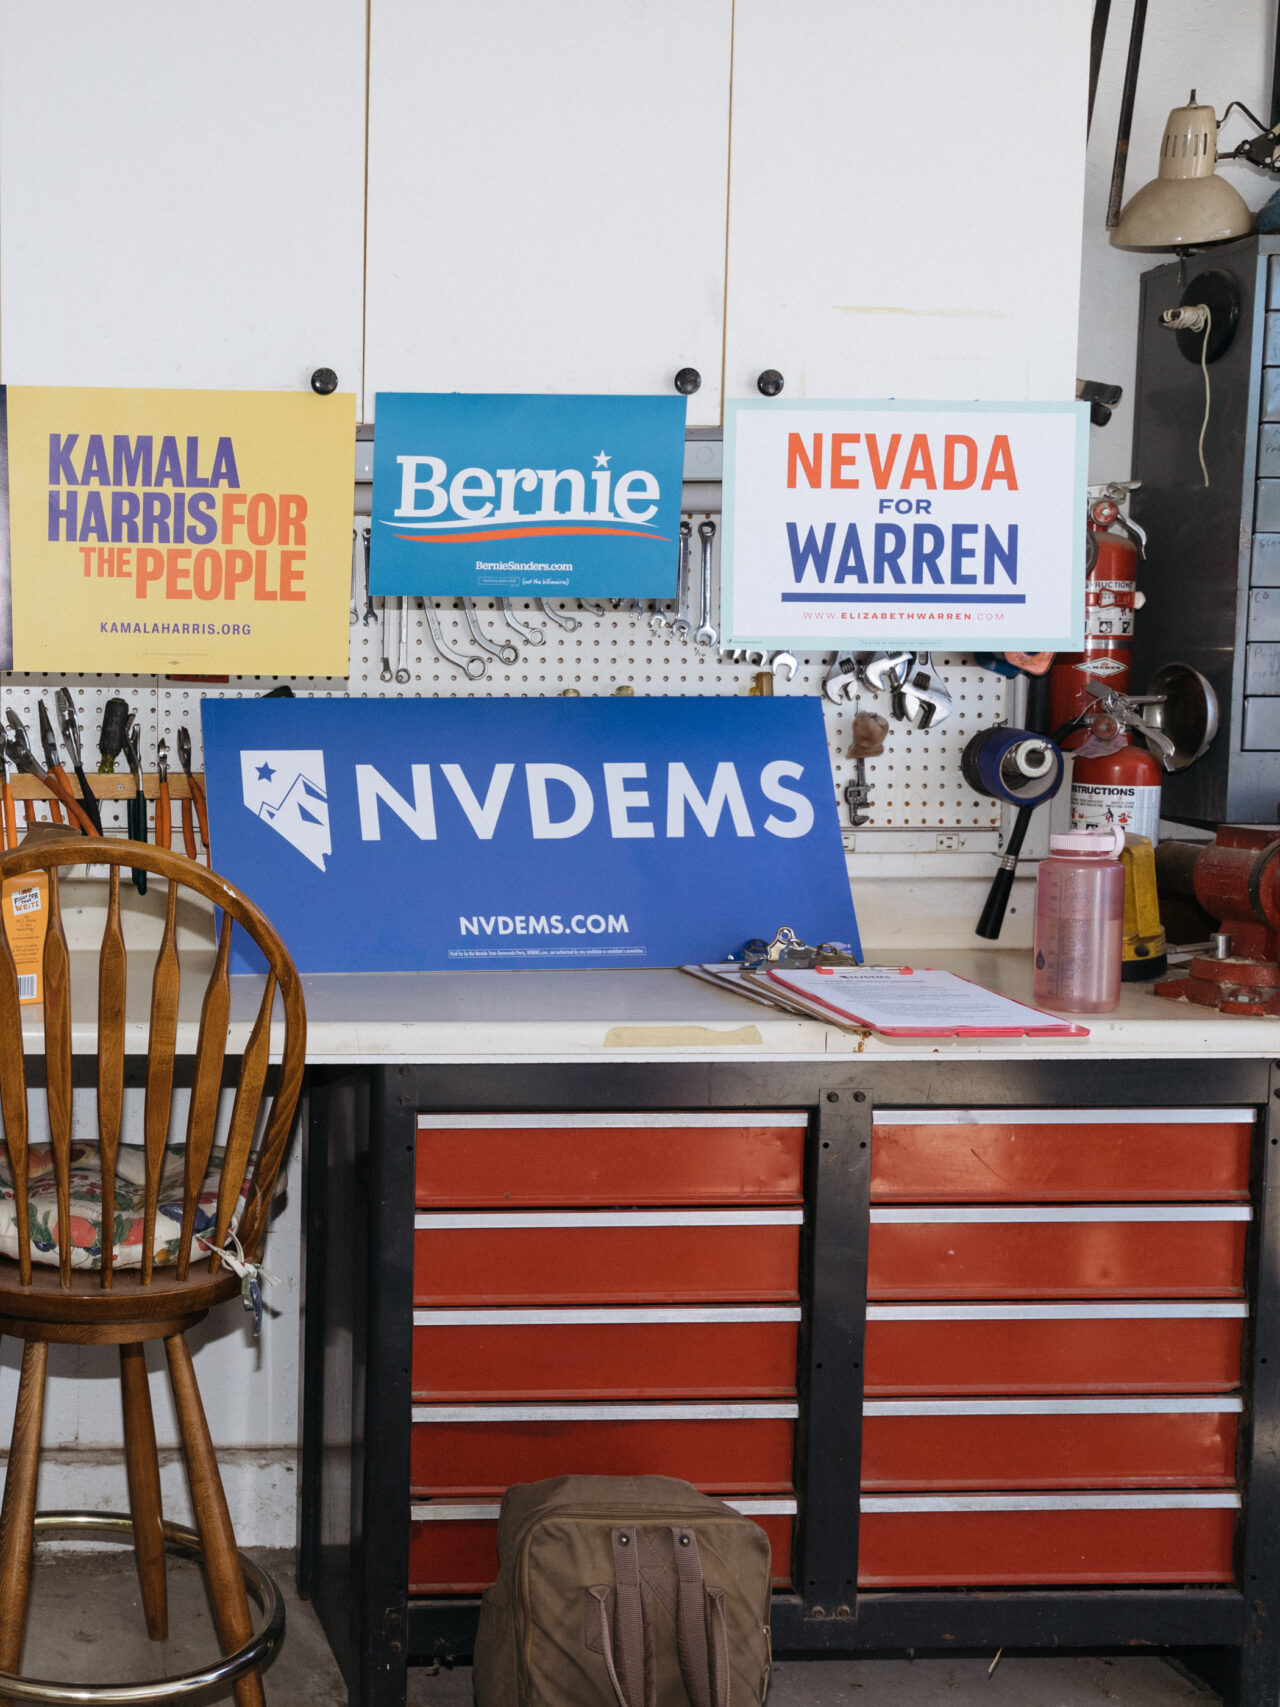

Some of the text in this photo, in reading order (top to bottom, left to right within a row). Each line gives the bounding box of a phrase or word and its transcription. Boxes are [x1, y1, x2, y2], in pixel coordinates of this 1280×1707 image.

[48, 433, 240, 488] KAMALA
[787, 432, 1019, 491] NEVADA
[394, 450, 660, 523] Bernie
[48, 490, 308, 546] HARRIS FOR
[878, 498, 932, 514] FOR
[475, 561, 573, 571] BernieSanders.com
[786, 522, 1019, 585] WARREN
[79, 547, 307, 602] THE PEOPLE
[100, 622, 251, 635] KAMALAHARRIS.ORG
[802, 612, 1005, 621] WWW.ELIZABETHWARREN.COM
[355, 761, 814, 840] NVDEMS
[1072, 785, 1135, 796] STRUCTIONS
[15, 901, 39, 912] WRITE
[459, 914, 629, 936] NVDEMS.COM
